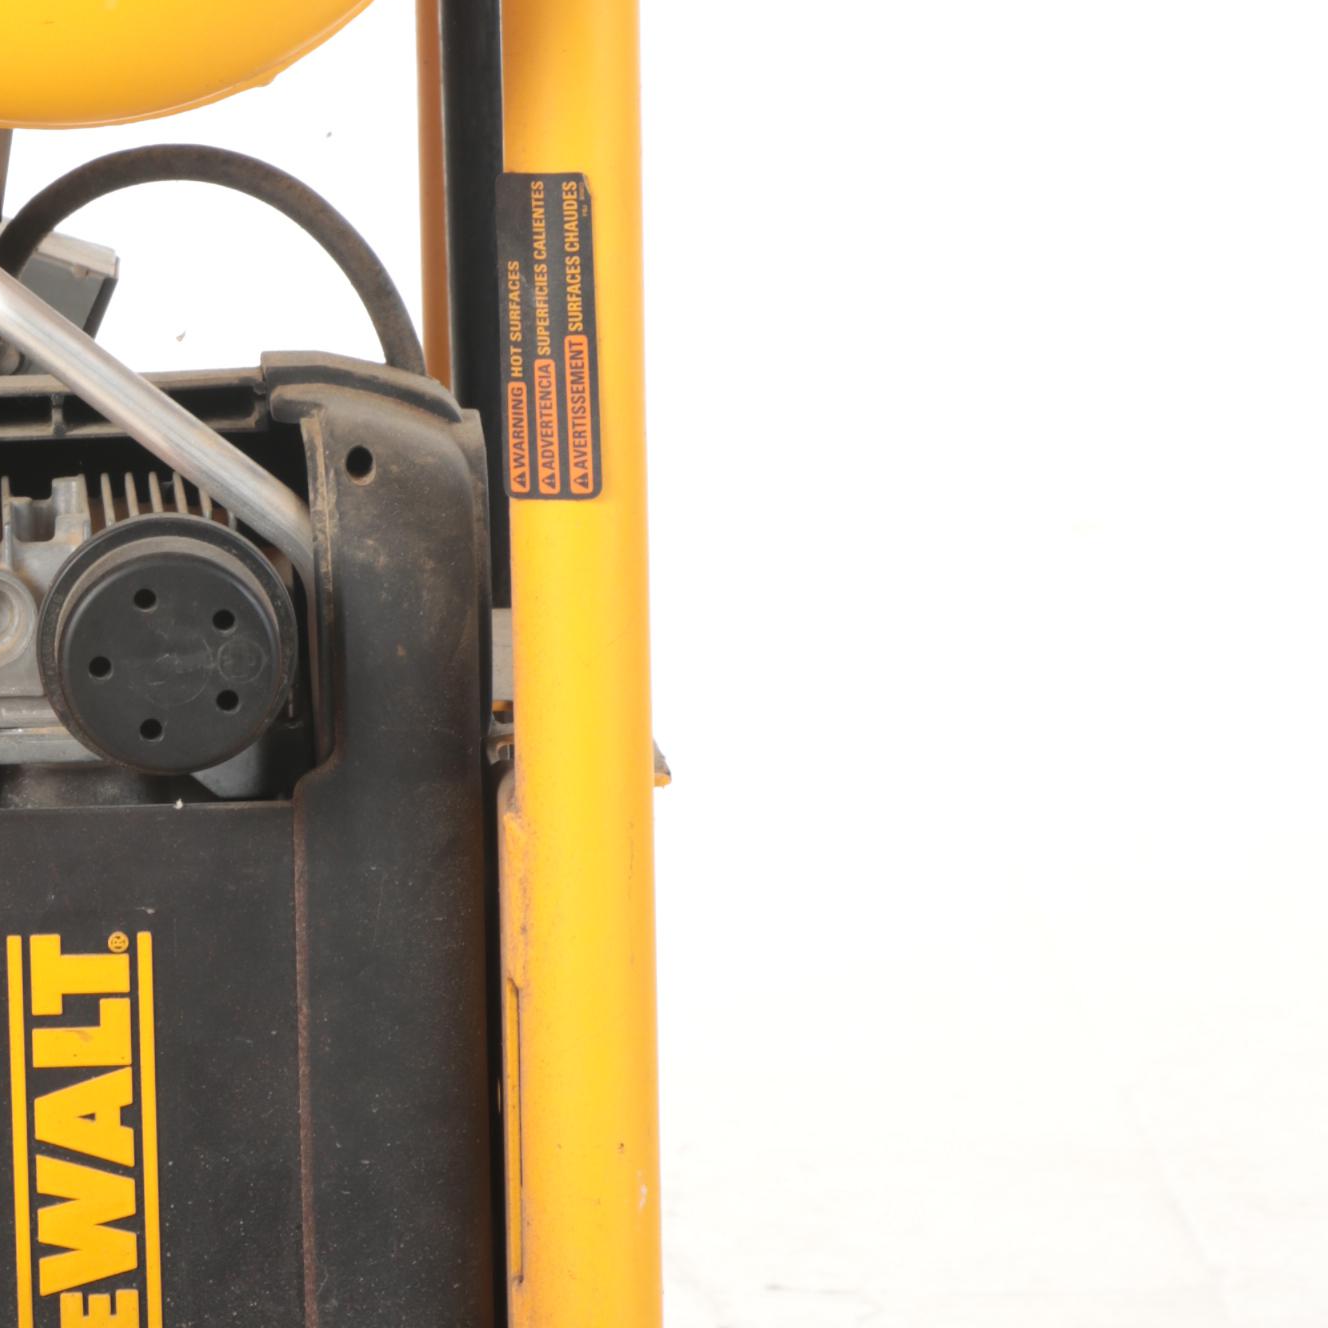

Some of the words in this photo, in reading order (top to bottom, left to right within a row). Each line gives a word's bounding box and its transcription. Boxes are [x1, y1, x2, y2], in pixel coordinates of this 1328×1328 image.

[530, 180, 547, 261] CALIENTES
[561, 180, 580, 253] CHAUDES
[507, 260, 522, 342] SURFACES
[533, 263, 551, 356] SUPERFICIES
[564, 255, 584, 332] SURFACES
[509, 346, 523, 378] HOT
[511, 386, 525, 469] WARNING
[537, 363, 554, 470] ADVERTENCIA
[568, 340, 589, 470] AVERTISSEMENT
